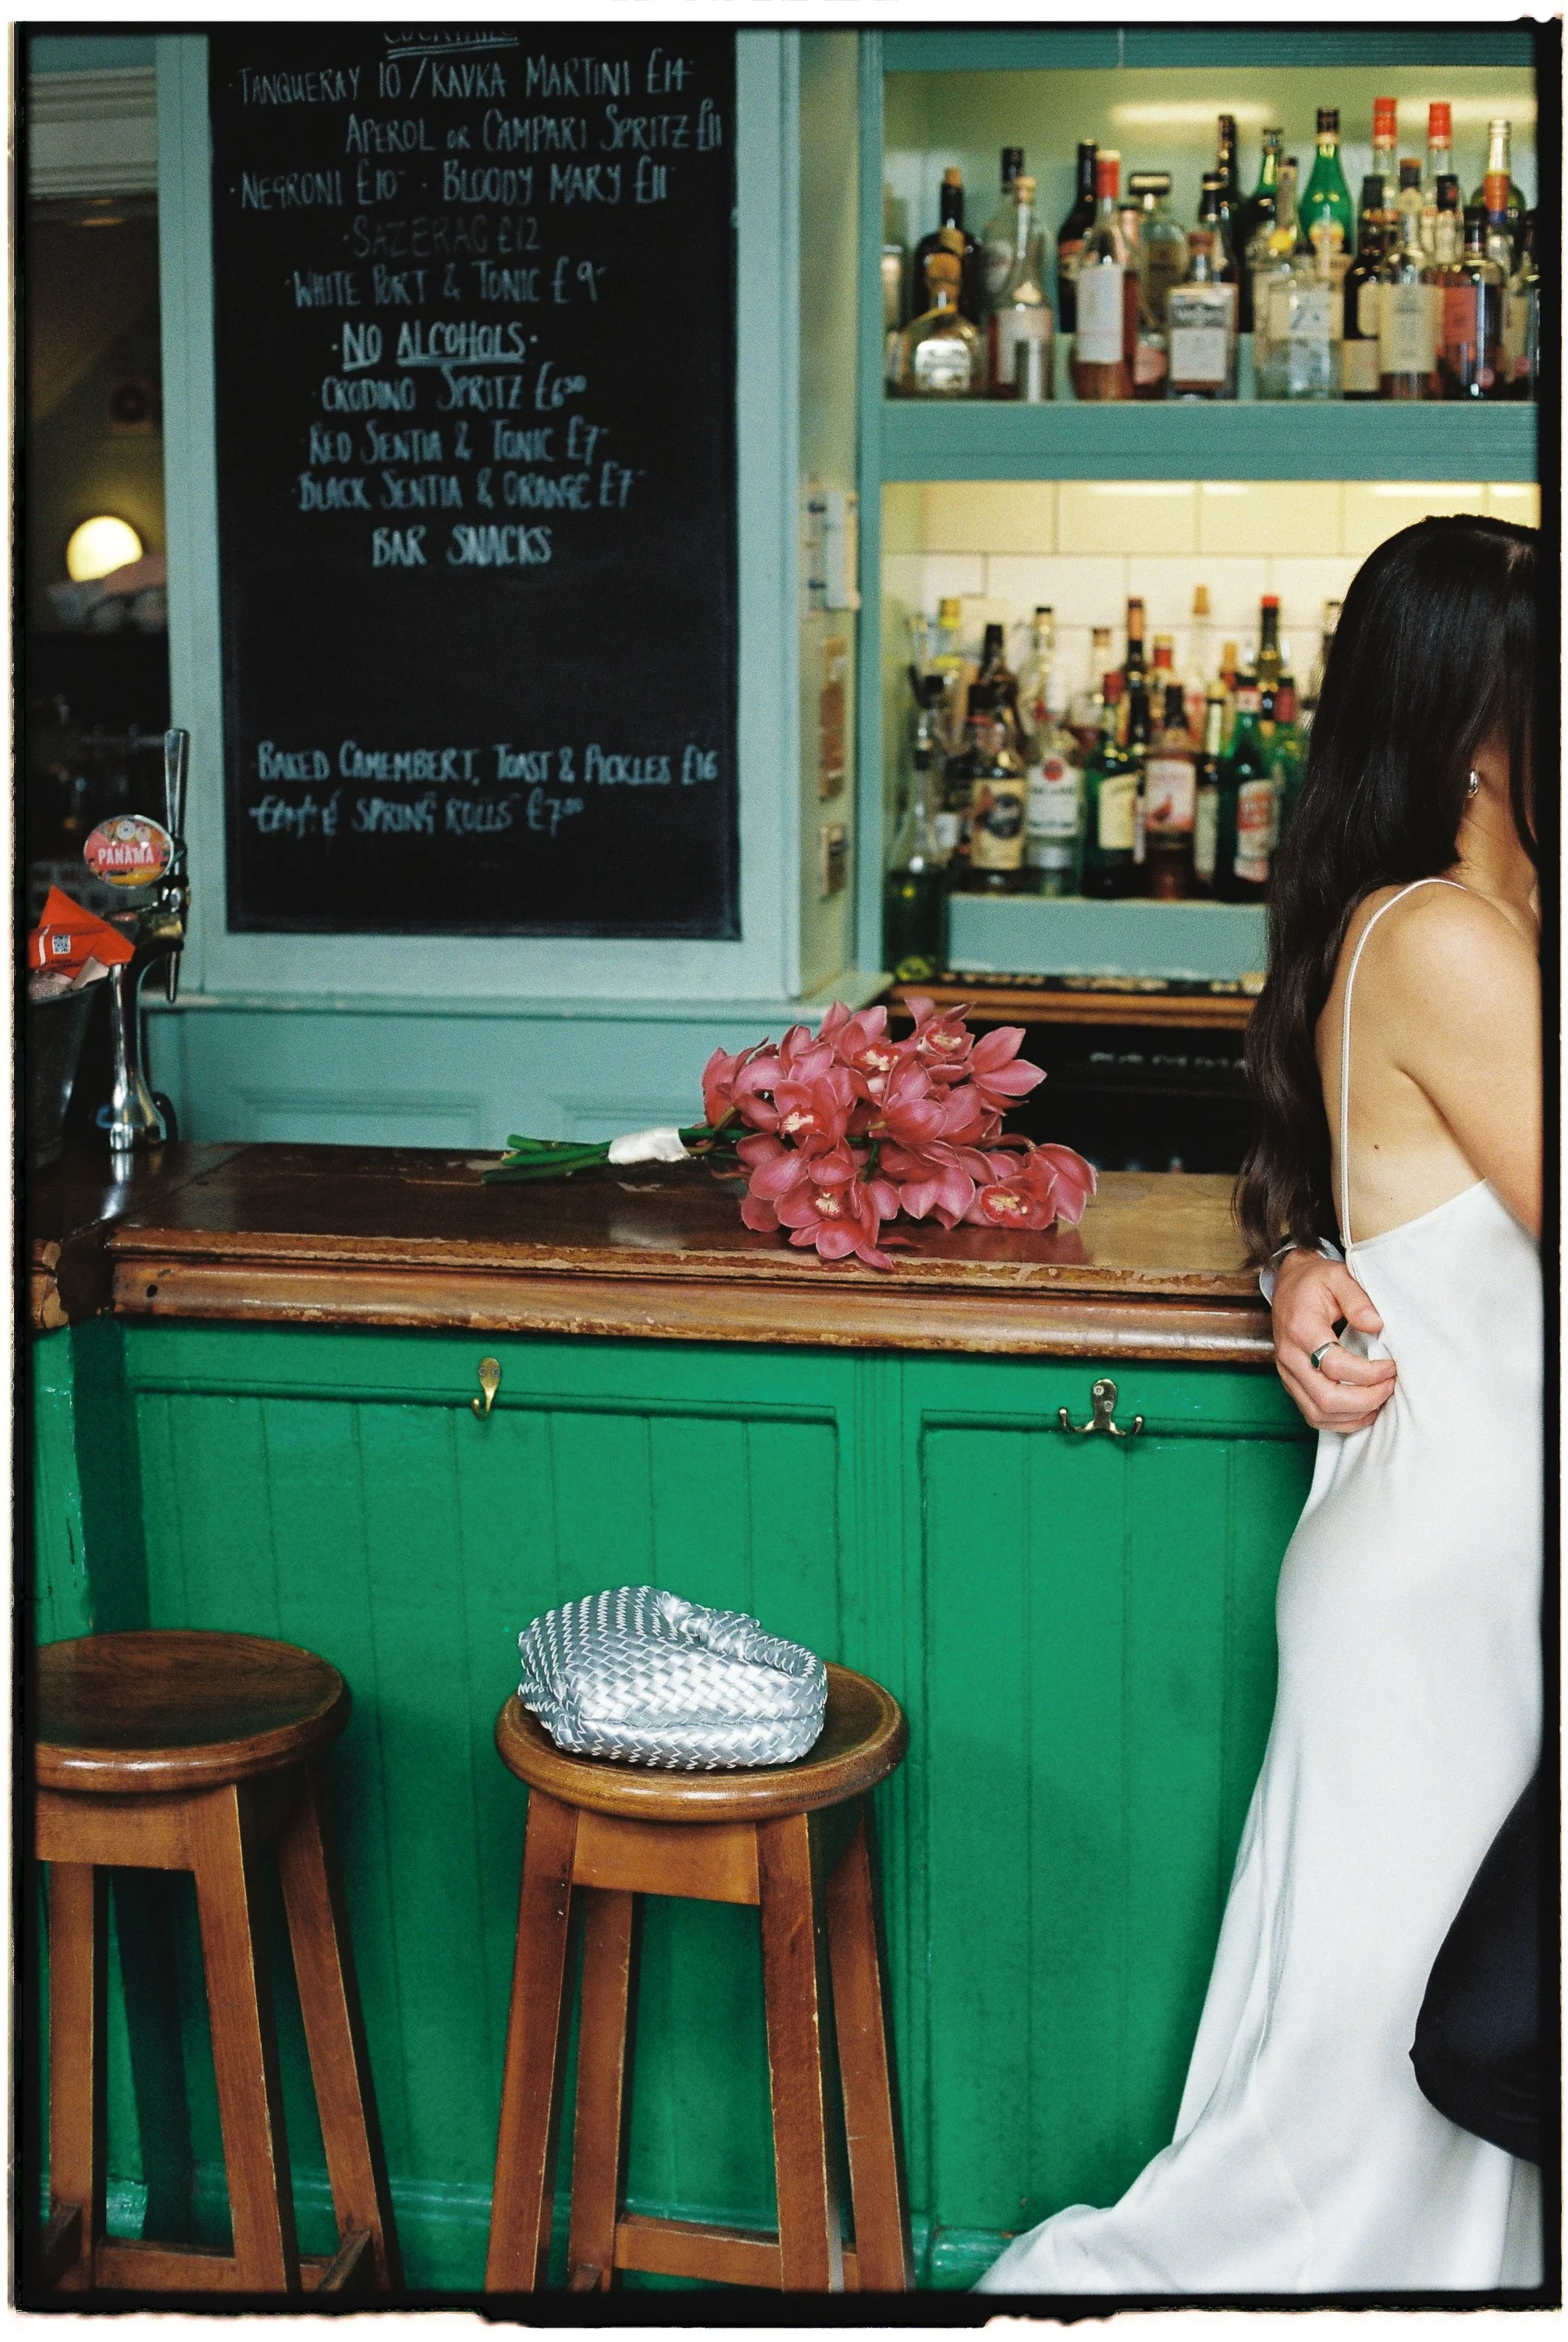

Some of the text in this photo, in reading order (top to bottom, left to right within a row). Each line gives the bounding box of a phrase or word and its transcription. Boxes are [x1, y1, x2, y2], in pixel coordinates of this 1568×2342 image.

[240, 65, 361, 105] TANQUERAY
[525, 54, 631, 98] MARTINI
[345, 112, 436, 155] APEROL
[482, 108, 587, 153] CAMPARI
[599, 103, 690, 151] SPRITZ
[241, 169, 343, 211] NEGRONI
[443, 158, 534, 207] BLOODY
[549, 162, 621, 205] MARY
[352, 212, 542, 258] SAZERAC £12
[293, 269, 361, 308] WHITE
[372, 263, 427, 306] PORT
[443, 262, 461, 301] &
[471, 259, 540, 303] TONIC
[342, 320, 526, 365] NO ALCOHOLS
[322, 376, 416, 413] CRODINO
[438, 365, 523, 412] SPRITZ
[309, 422, 353, 466] RED
[454, 420, 472, 461] &
[492, 418, 554, 461] TONIC
[298, 471, 372, 511] BLACK
[476, 466, 495, 509] &
[503, 472, 591, 510] ORANGE
[372, 524, 552, 568] BAR SNACKS
[257, 740, 331, 781] BAKED
[493, 743, 553, 784] TOAST
[558, 746, 576, 784] &
[584, 743, 672, 787] PICKLES
[352, 791, 437, 835] SPRING
[445, 794, 515, 835] ROLLS
[98, 848, 155, 865] PANAMA
